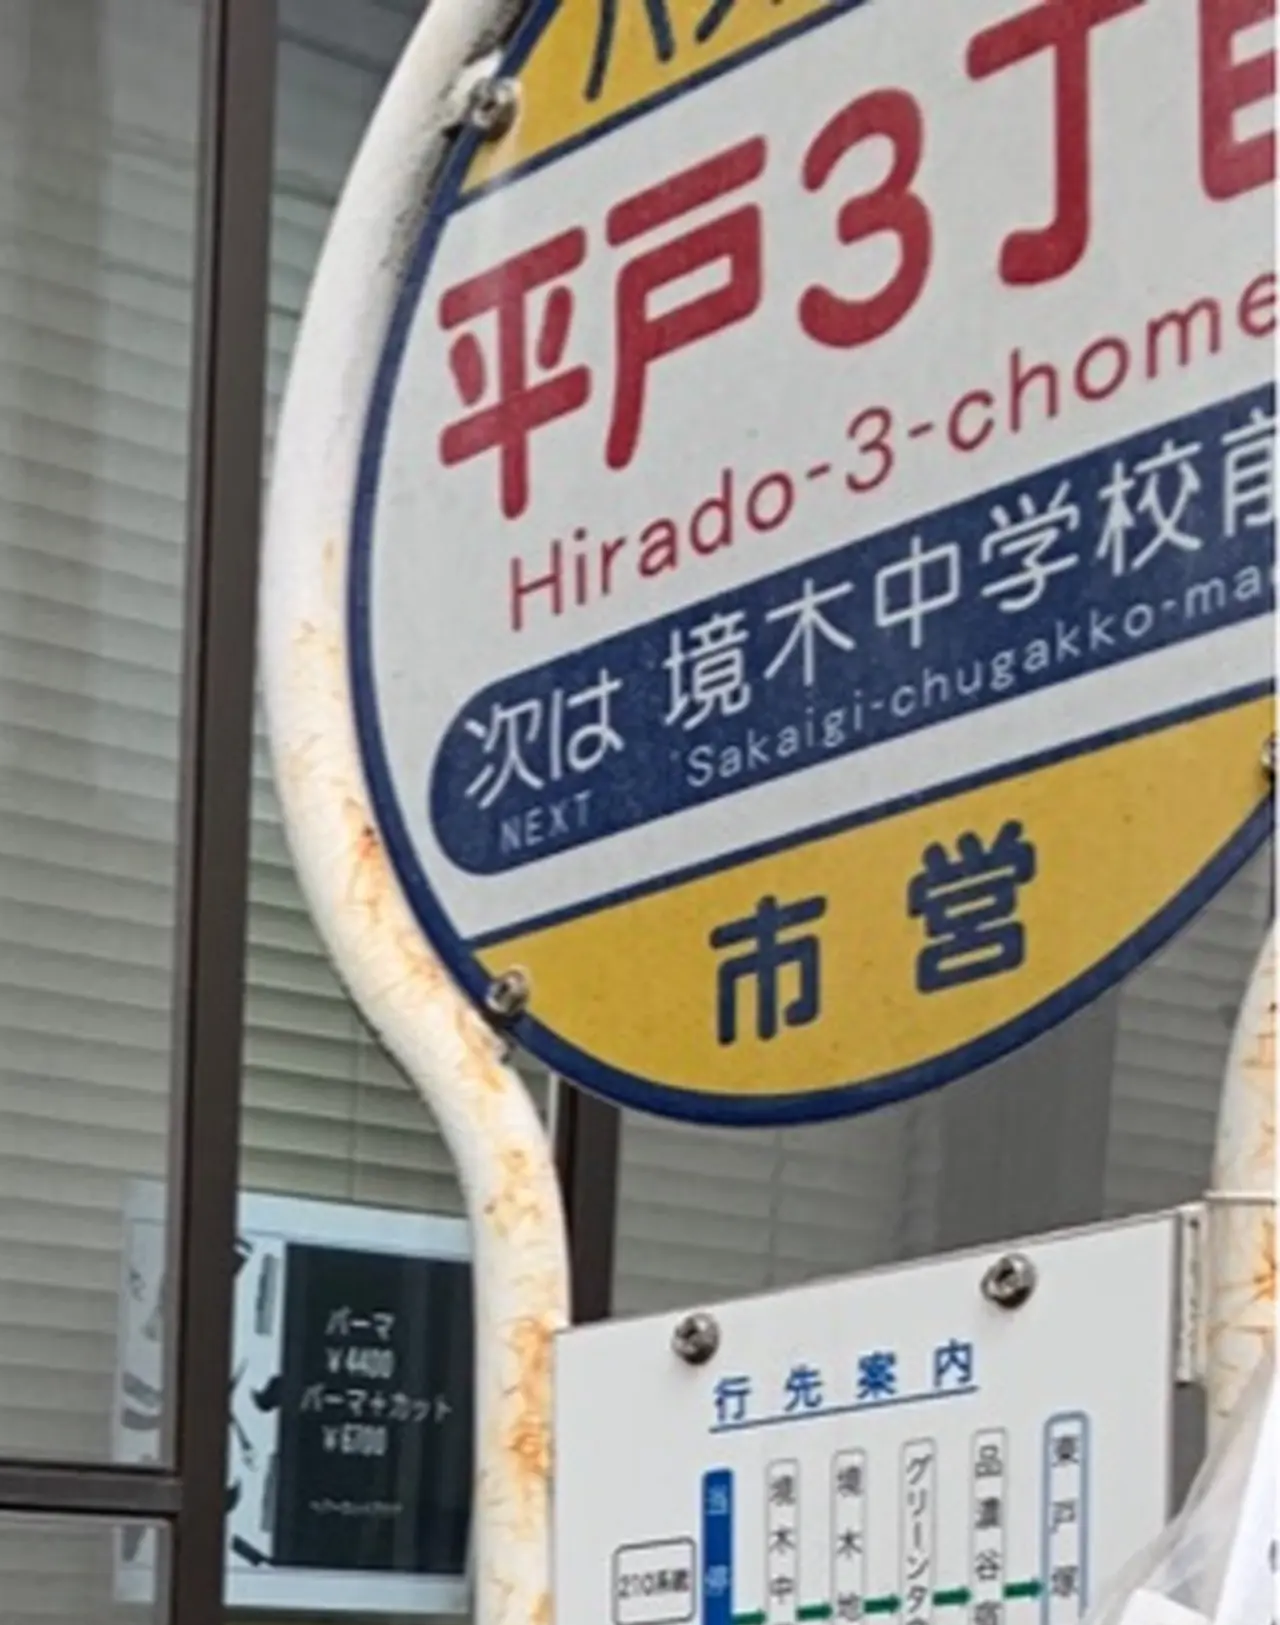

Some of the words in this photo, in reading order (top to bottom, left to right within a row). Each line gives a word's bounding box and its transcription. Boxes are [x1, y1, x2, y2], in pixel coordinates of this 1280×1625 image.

[509, 272, 1276, 631] Hirado-3-chome
[464, 668, 626, 809] 次は
[499, 790, 592, 854] NEXT
[685, 566, 1276, 788] Sakaigi-chugakko-ma
[710, 819, 1038, 1046] 市営
[325, 1306, 396, 1341] パーマ
[713, 1339, 975, 1421] 行先案内
